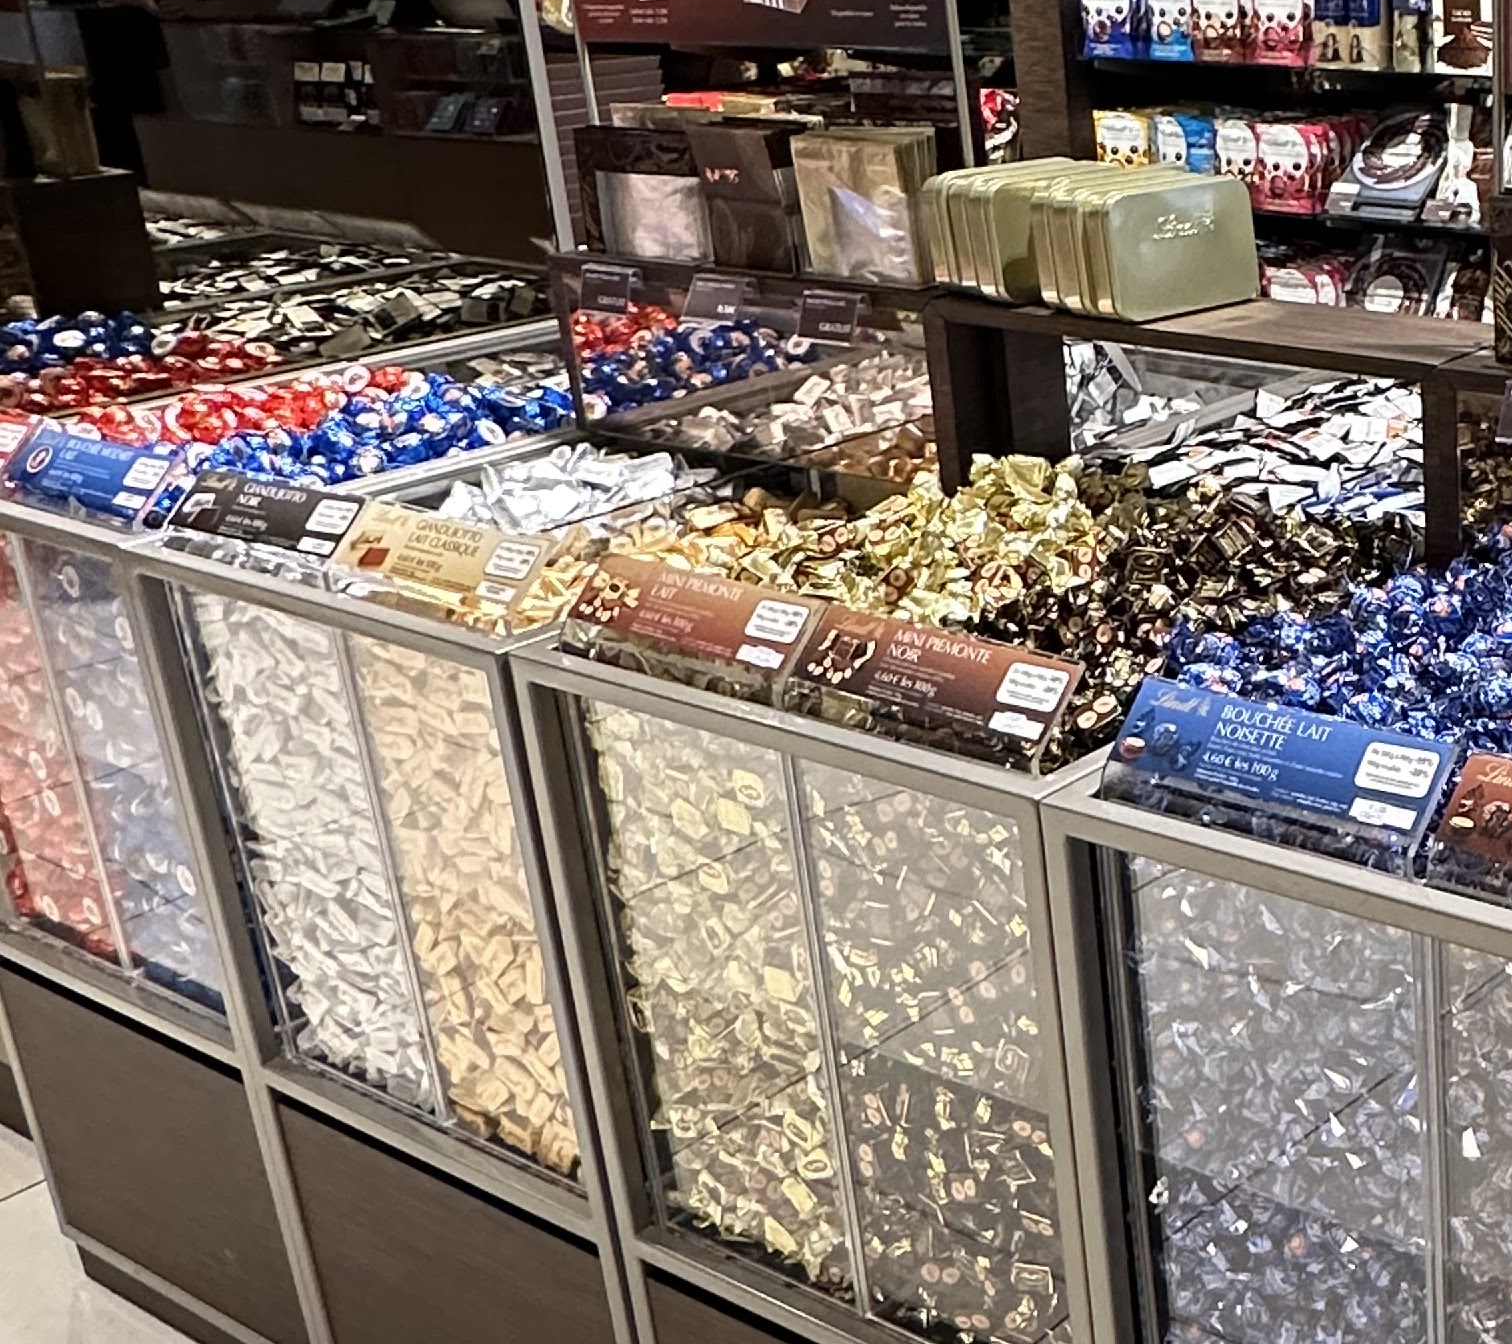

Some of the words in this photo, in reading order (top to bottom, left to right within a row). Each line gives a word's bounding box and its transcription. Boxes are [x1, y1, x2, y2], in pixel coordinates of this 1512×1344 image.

[428, 537, 481, 557] CLASSIQUE
[659, 571, 684, 588] MINI
[650, 586, 678, 600] LAIT
[887, 643, 922, 663] NOIR
[894, 628, 925, 646] MINI
[925, 634, 994, 665] PIEMONTE
[1151, 688, 1190, 712] Lindt
[1221, 704, 1296, 734] BOUCHÉE
[1296, 723, 1334, 742] LAIT
[1214, 722, 1287, 751] NOISETTE
[1203, 751, 1225, 765] 4,60
[1234, 758, 1250, 772] les
